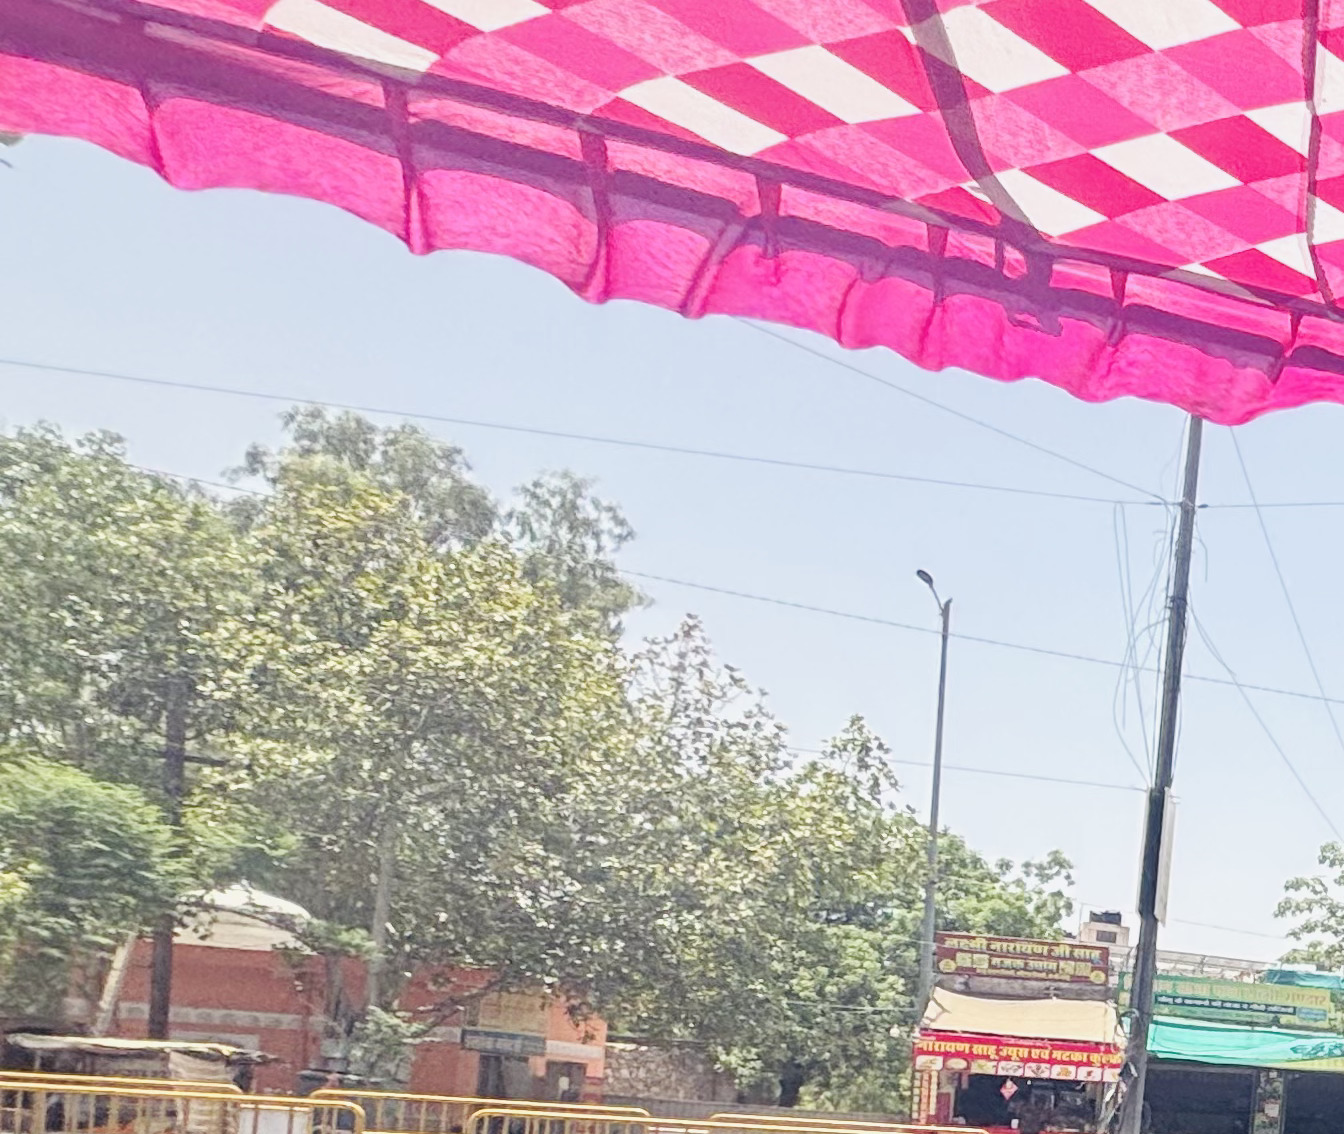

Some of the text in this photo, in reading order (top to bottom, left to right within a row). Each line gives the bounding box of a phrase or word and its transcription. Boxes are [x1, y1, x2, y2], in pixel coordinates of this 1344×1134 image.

[916, 1039, 970, 1055] नारायण
[972, 1043, 999, 1060] साहू
[1052, 1049, 1089, 1063] मटका
